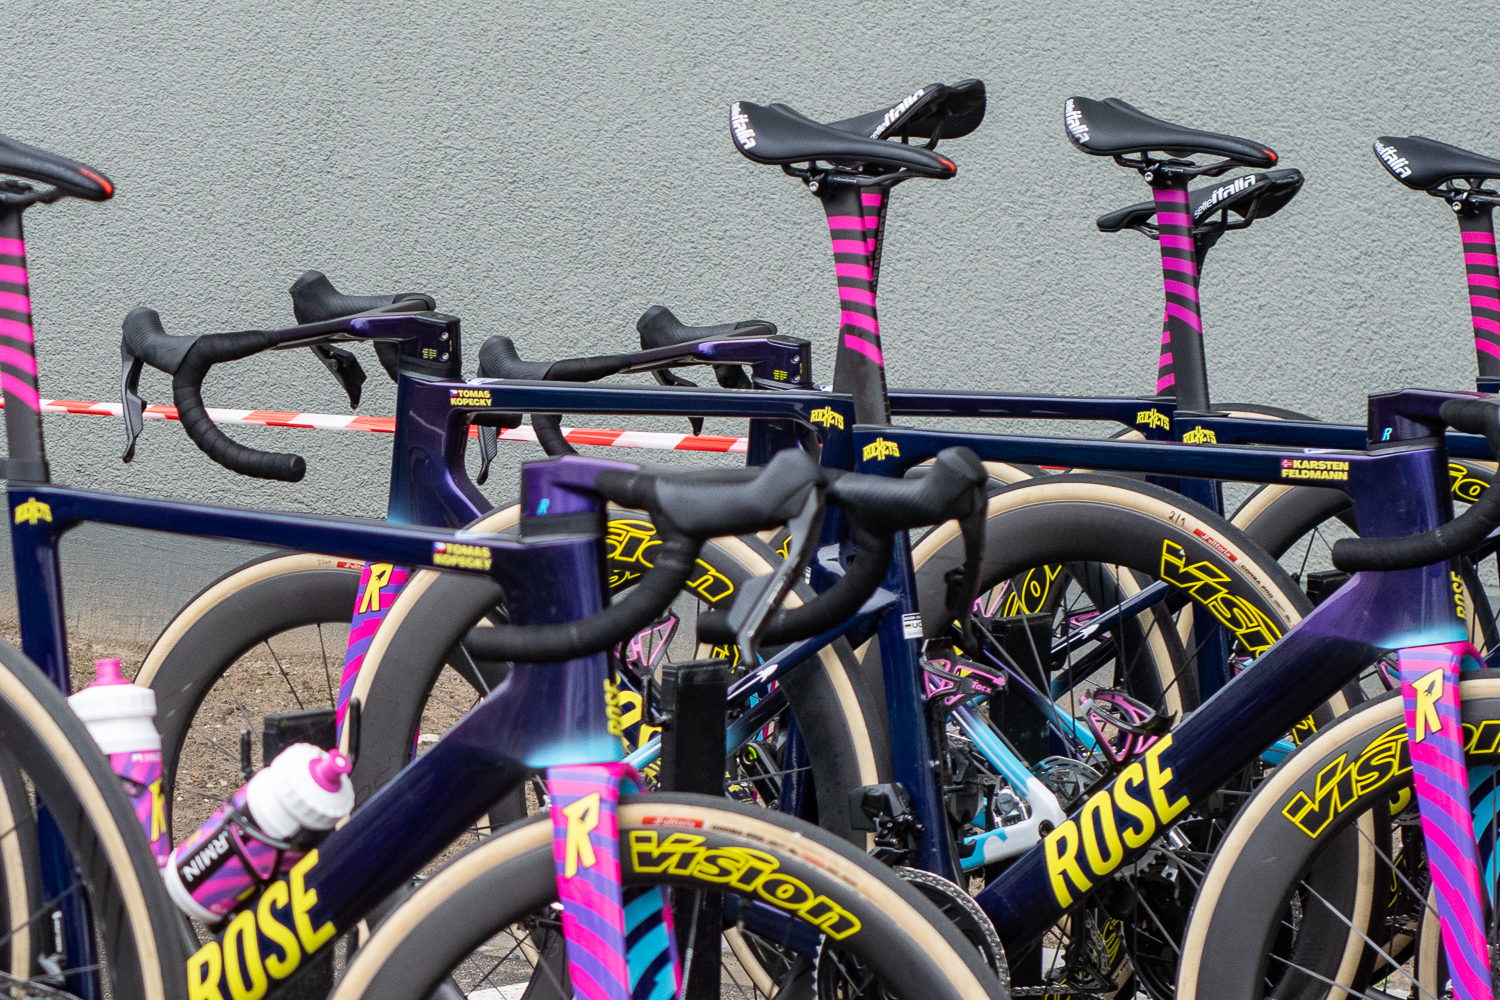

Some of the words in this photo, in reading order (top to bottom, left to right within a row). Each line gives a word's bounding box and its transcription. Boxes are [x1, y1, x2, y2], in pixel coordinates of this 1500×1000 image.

[884, 88, 925, 127] italia
[731, 113, 757, 150] italia
[1066, 110, 1090, 144] italia
[1380, 145, 1413, 179] italia
[1194, 198, 1213, 219] selle
[1211, 174, 1257, 205] italia
[450, 397, 492, 407] KOPECKY
[457, 389, 491, 399] TOMAS
[810, 406, 844, 430] ROCKETS
[1136, 408, 1170, 431] ROCKETS
[1182, 426, 1217, 445] ROCKETS
[1381, 427, 1393, 441] R
[863, 437, 900, 462] ROCKETS
[1281, 468, 1349, 481] FELDMANN
[1292, 459, 1349, 472] KARSTEN
[432, 552, 493, 572] KOPECKY
[445, 542, 492, 559] TOMAS
[358, 563, 394, 614] R
[971, 680, 992, 695] Tacx
[1410, 668, 1443, 744] R
[1044, 733, 1191, 909] ROSE
[562, 792, 601, 879] R
[629, 831, 862, 941] Vision
